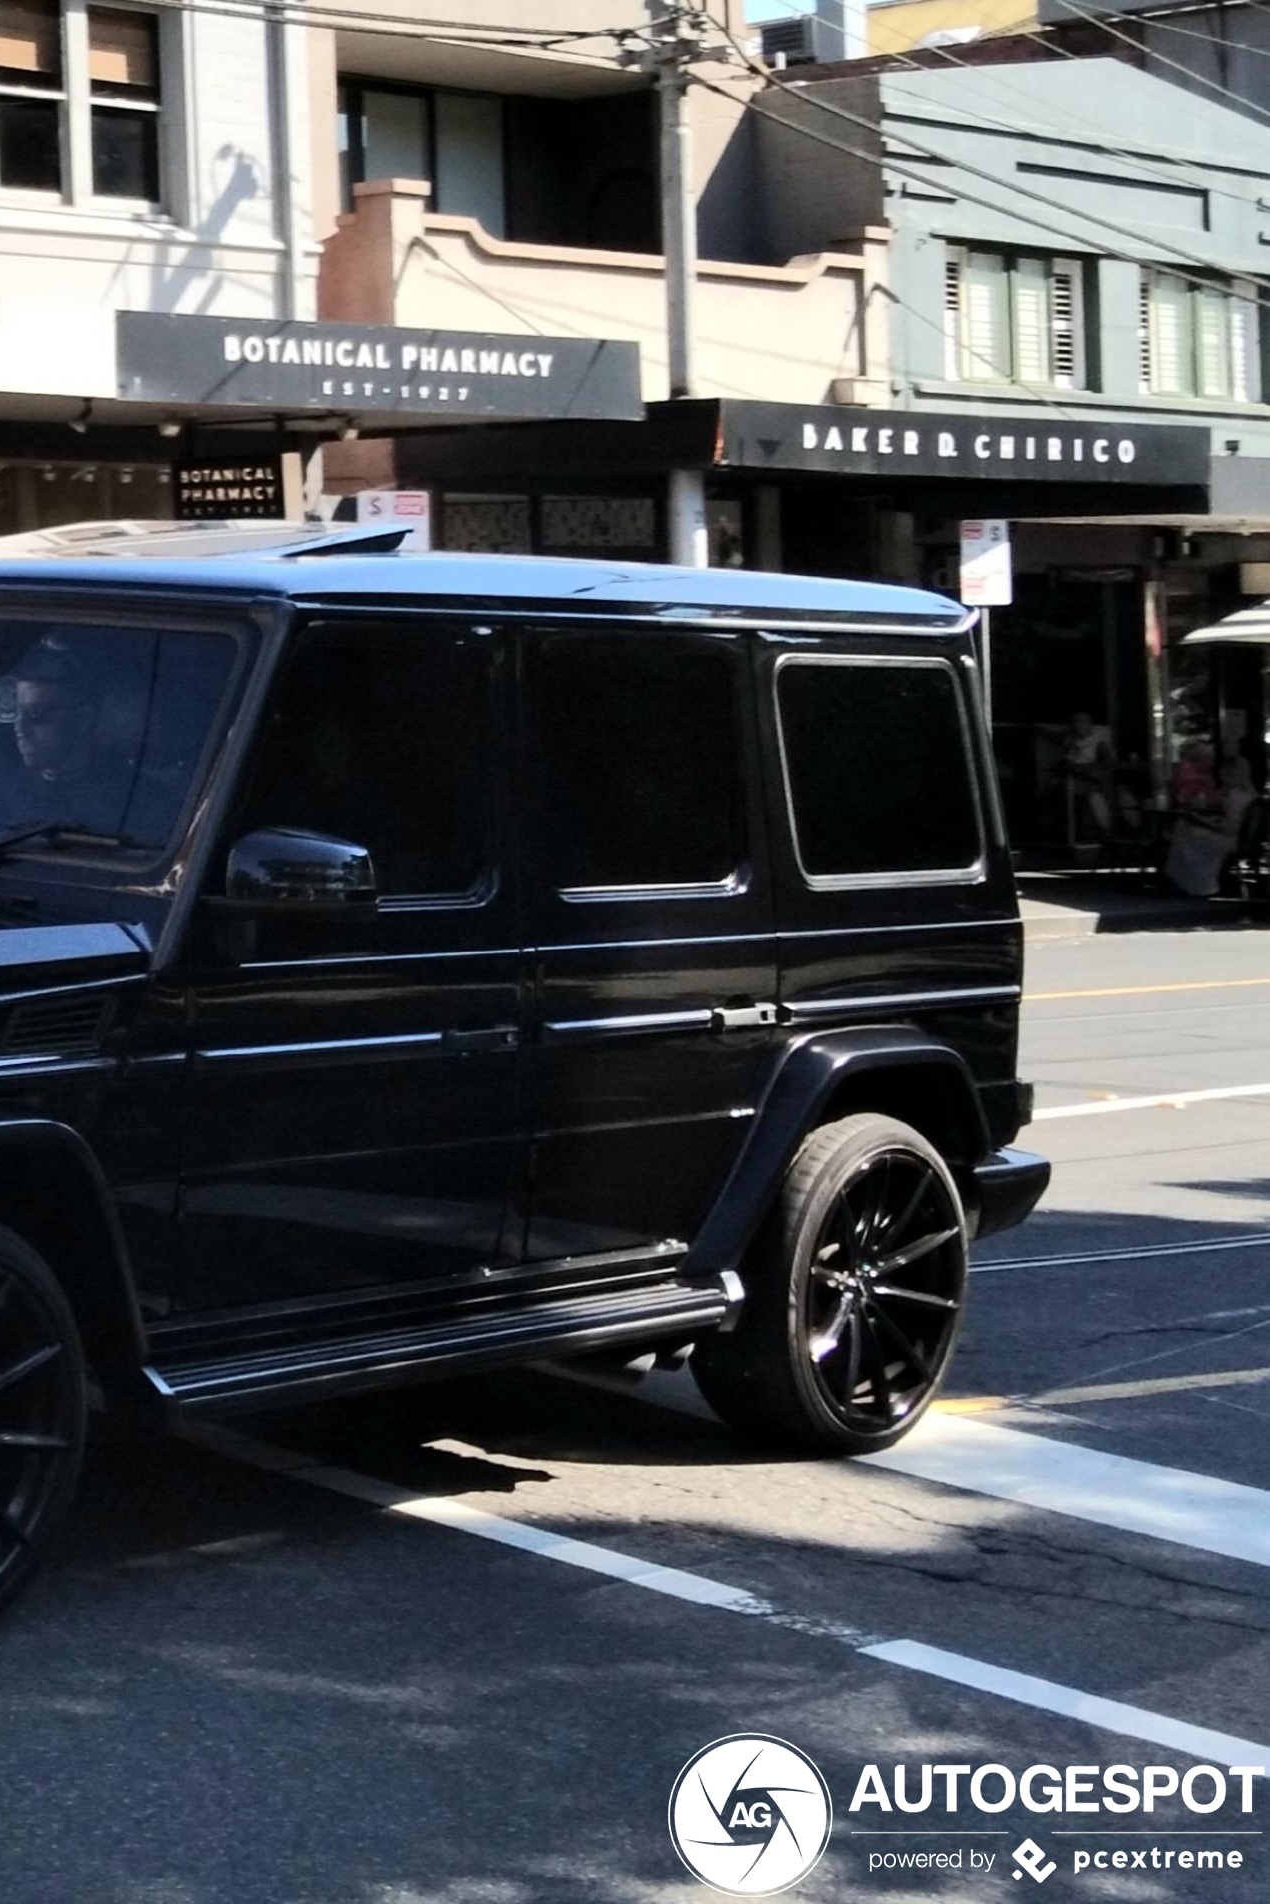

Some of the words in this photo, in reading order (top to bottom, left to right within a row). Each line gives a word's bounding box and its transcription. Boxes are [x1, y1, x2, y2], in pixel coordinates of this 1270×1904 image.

[224, 336, 391, 369] BOTANICAL
[401, 345, 554, 378] PHARMACY
[803, 423, 919, 455] BAKER
[974, 434, 1136, 463] CHIRICO
[180, 467, 274, 483] BOTANICAL
[181, 486, 275, 501] PHARMACY
